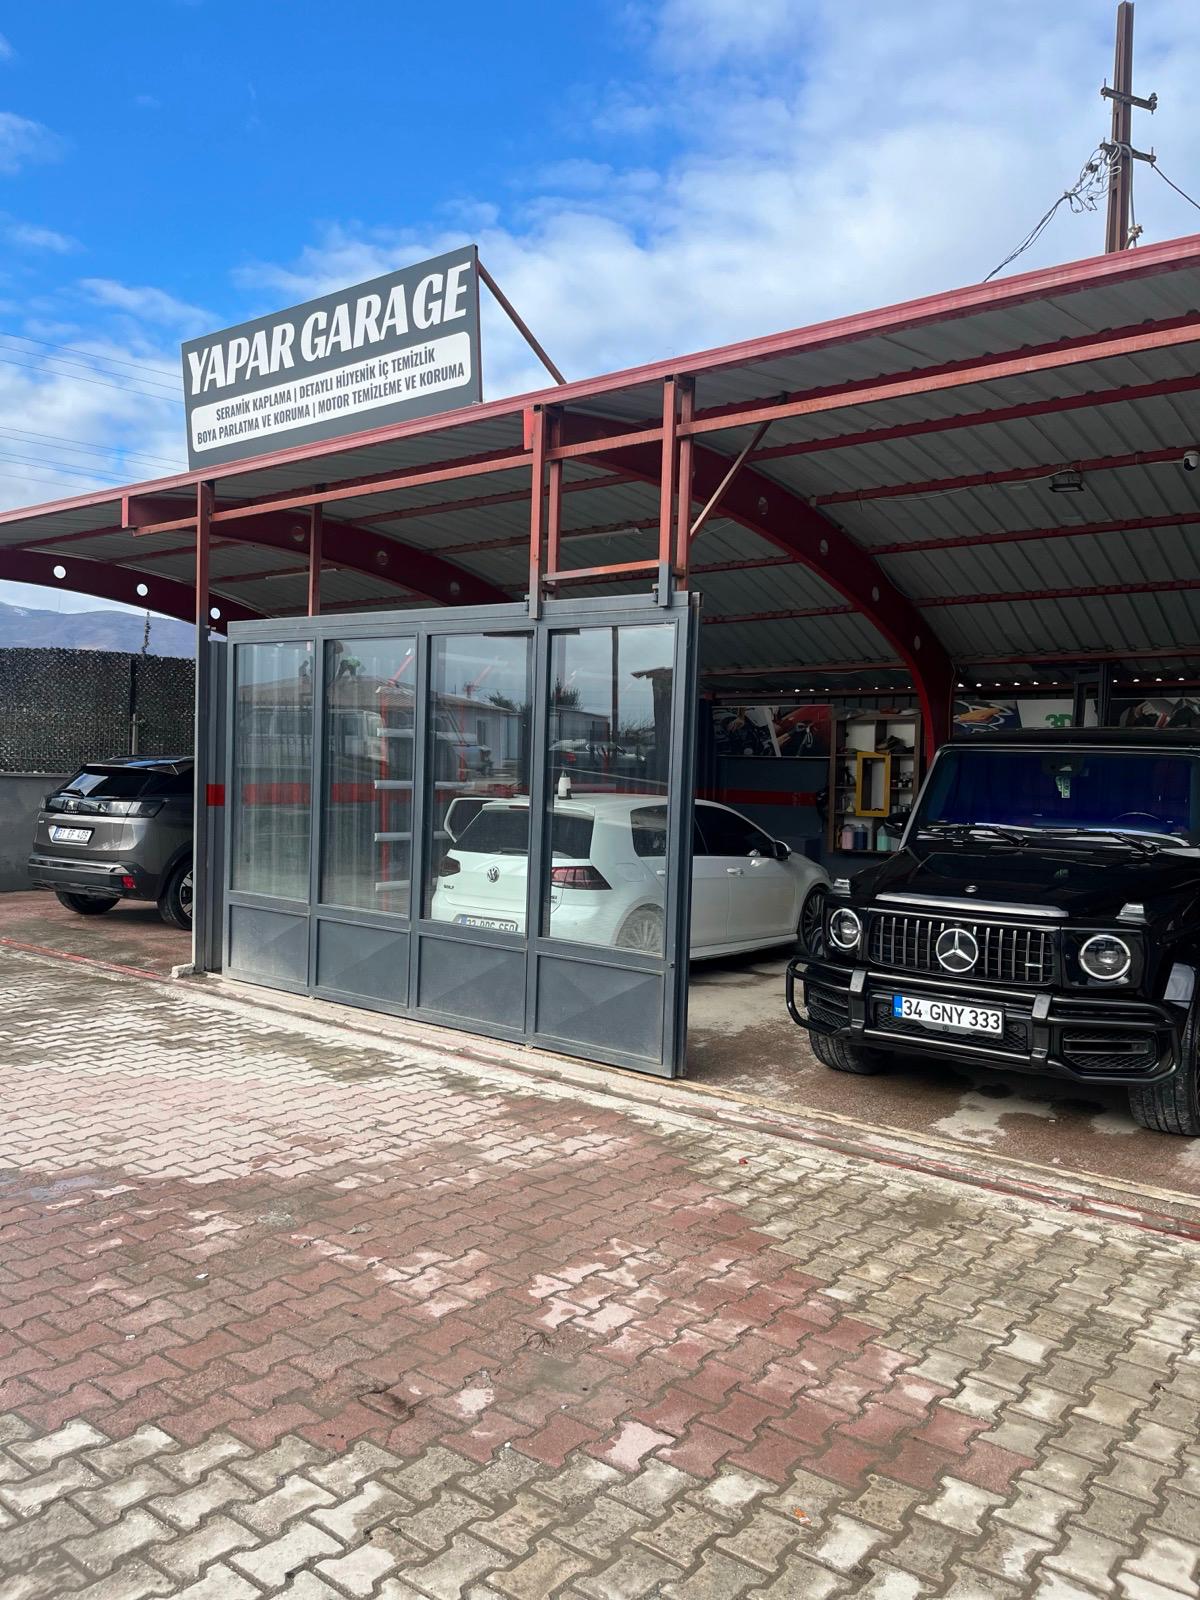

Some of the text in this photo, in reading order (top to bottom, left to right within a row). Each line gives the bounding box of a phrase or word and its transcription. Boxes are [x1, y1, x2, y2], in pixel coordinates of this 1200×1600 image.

[187, 261, 471, 396] YAPAR GARAGE
[197, 429, 218, 445] BOYA
[219, 418, 260, 439] PARLATMA
[261, 414, 272, 428] VE
[273, 404, 311, 426] KORUMA
[318, 394, 350, 414] MOTOR
[352, 382, 403, 405] TEMİZLEME
[404, 375, 417, 391] VE
[419, 362, 465, 388] KORUMA
[216, 398, 251, 421] SERAMİK
[252, 390, 292, 413] KAPLAMA
[299, 376, 334, 399] DETAYLI
[379, 360, 389, 379] İÇ
[391, 346, 436, 373] TEMİZLİK
[903, 999, 922, 1018] 34
[930, 1004, 965, 1025] GNY
[969, 1009, 1000, 1030] 333
